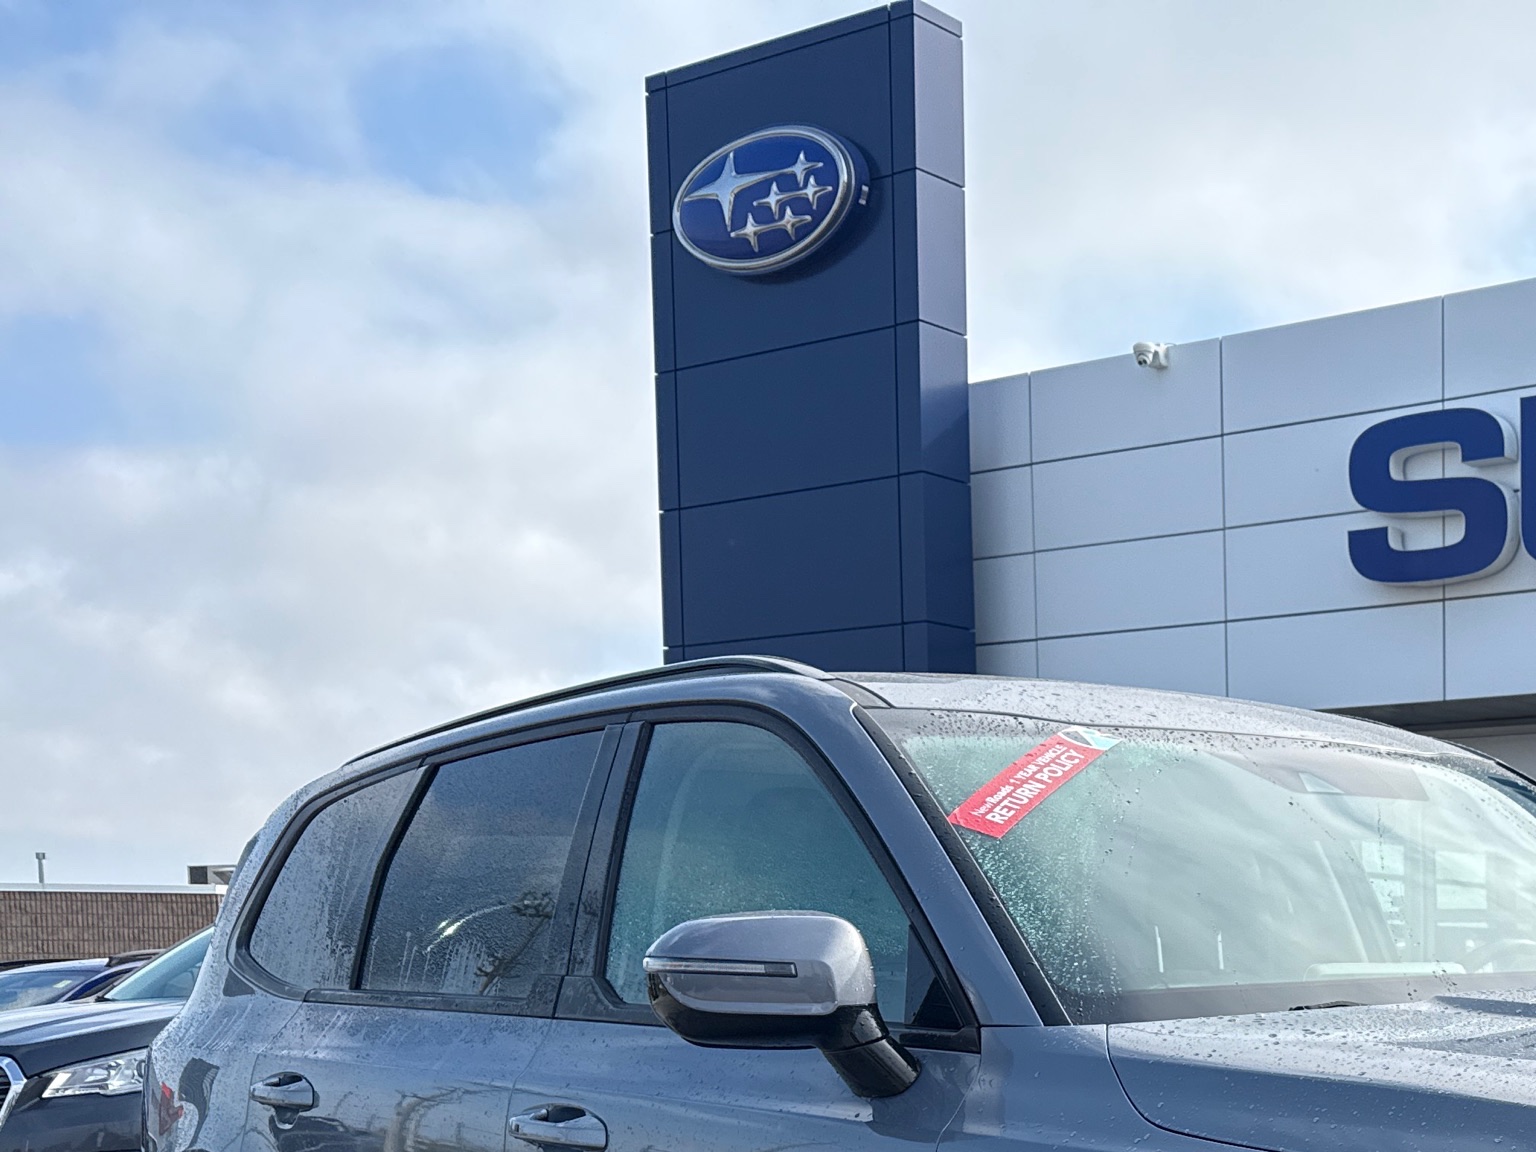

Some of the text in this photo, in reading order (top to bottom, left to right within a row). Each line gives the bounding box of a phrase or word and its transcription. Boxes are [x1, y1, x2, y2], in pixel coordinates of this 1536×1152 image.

[985, 749, 1085, 824] RETURN POLICY
[1014, 764, 1040, 779] YEAR
[1035, 744, 1067, 766] VEHICLE
